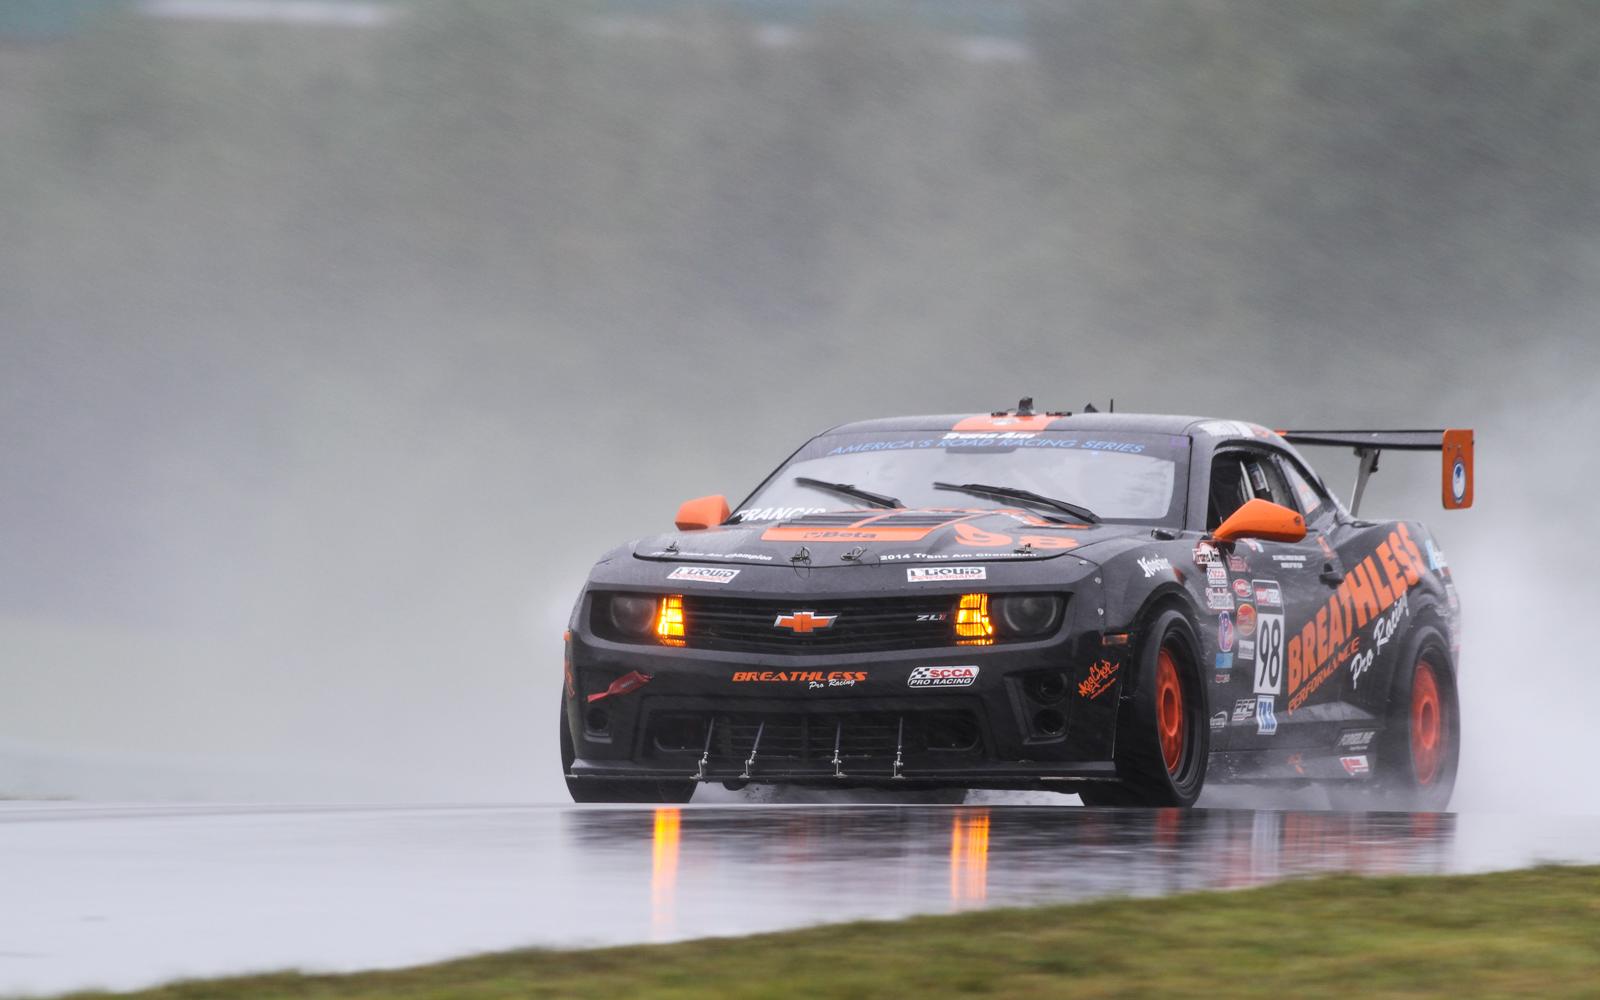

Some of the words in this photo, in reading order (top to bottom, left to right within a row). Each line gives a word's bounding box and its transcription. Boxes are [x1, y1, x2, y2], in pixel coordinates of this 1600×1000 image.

[827, 440, 931, 456] AMERICA'S
[936, 438, 995, 448] ROAD
[998, 438, 1075, 448] RACING
[1081, 440, 1145, 453] SERIES
[954, 523, 1079, 549] 98
[1288, 522, 1425, 696] BREATHLESS
[1259, 618, 1281, 689] 98
[732, 671, 868, 682] BREATHLESS
[929, 668, 974, 678] SCCA
[1350, 648, 1375, 690] Pro
[809, 681, 824, 690] Pro
[828, 678, 855, 688] Racing
[932, 677, 972, 685] RACING
